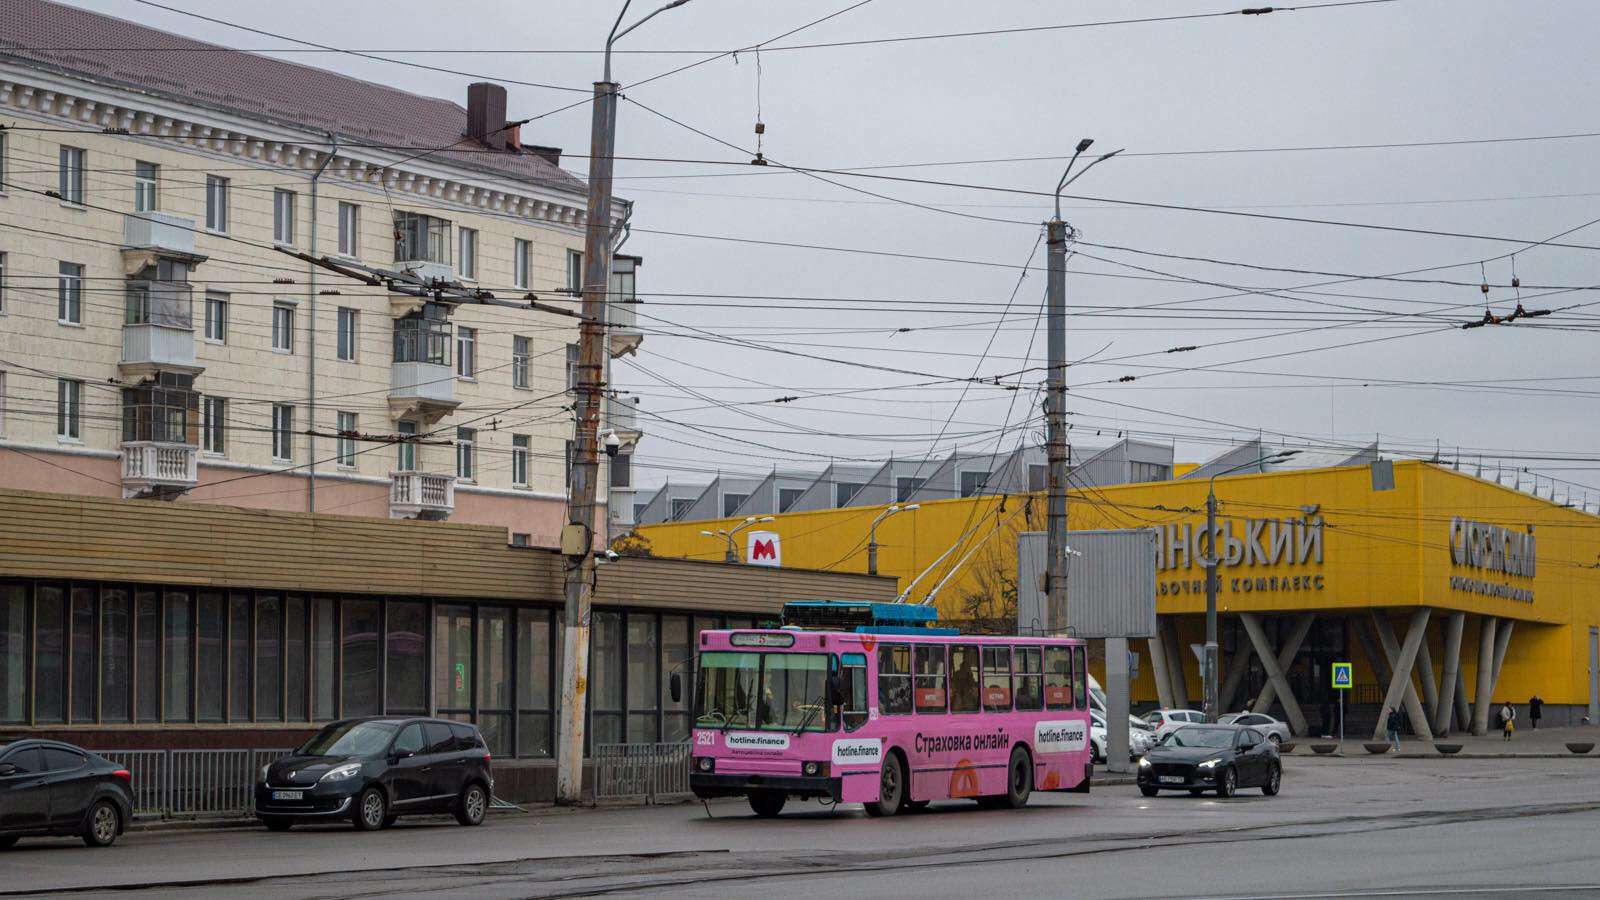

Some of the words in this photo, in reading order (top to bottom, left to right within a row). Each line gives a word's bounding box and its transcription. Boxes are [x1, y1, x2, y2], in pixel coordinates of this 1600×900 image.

[1232, 575, 1325, 593] КОМПЛЕКС
[696, 731, 715, 745] 2521
[730, 736, 785, 746] hotline.finance
[915, 732, 971, 757] Страховка
[974, 728, 1009, 749] онлайн
[1038, 728, 1084, 744] hotline.finance
[837, 745, 879, 757] hotline.finance
